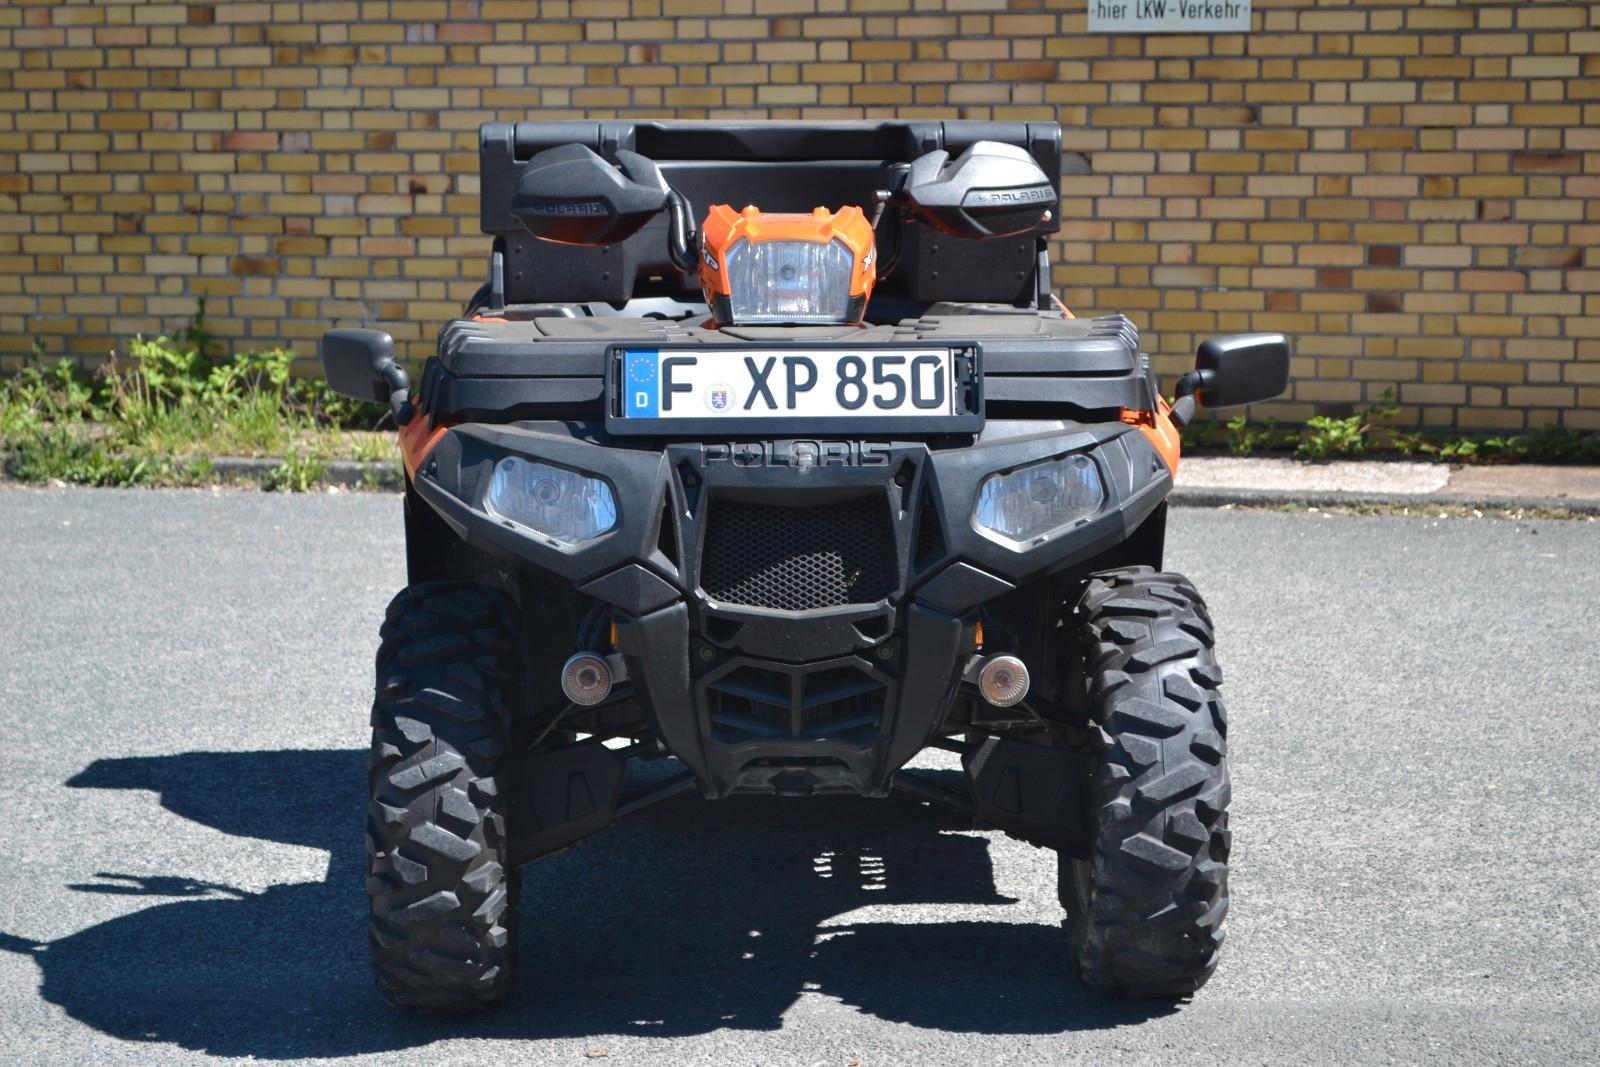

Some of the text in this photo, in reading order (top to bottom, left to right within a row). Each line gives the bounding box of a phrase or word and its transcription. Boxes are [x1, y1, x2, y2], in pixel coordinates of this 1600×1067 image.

[1097, 0, 1241, 19] hier LKW-Verkehr
[991, 188, 1054, 202] POLARIS
[533, 202, 606, 216] POLARIS
[661, 355, 945, 411] F XP 850
[635, 392, 648, 407] D
[700, 440, 892, 468] POLARIS
